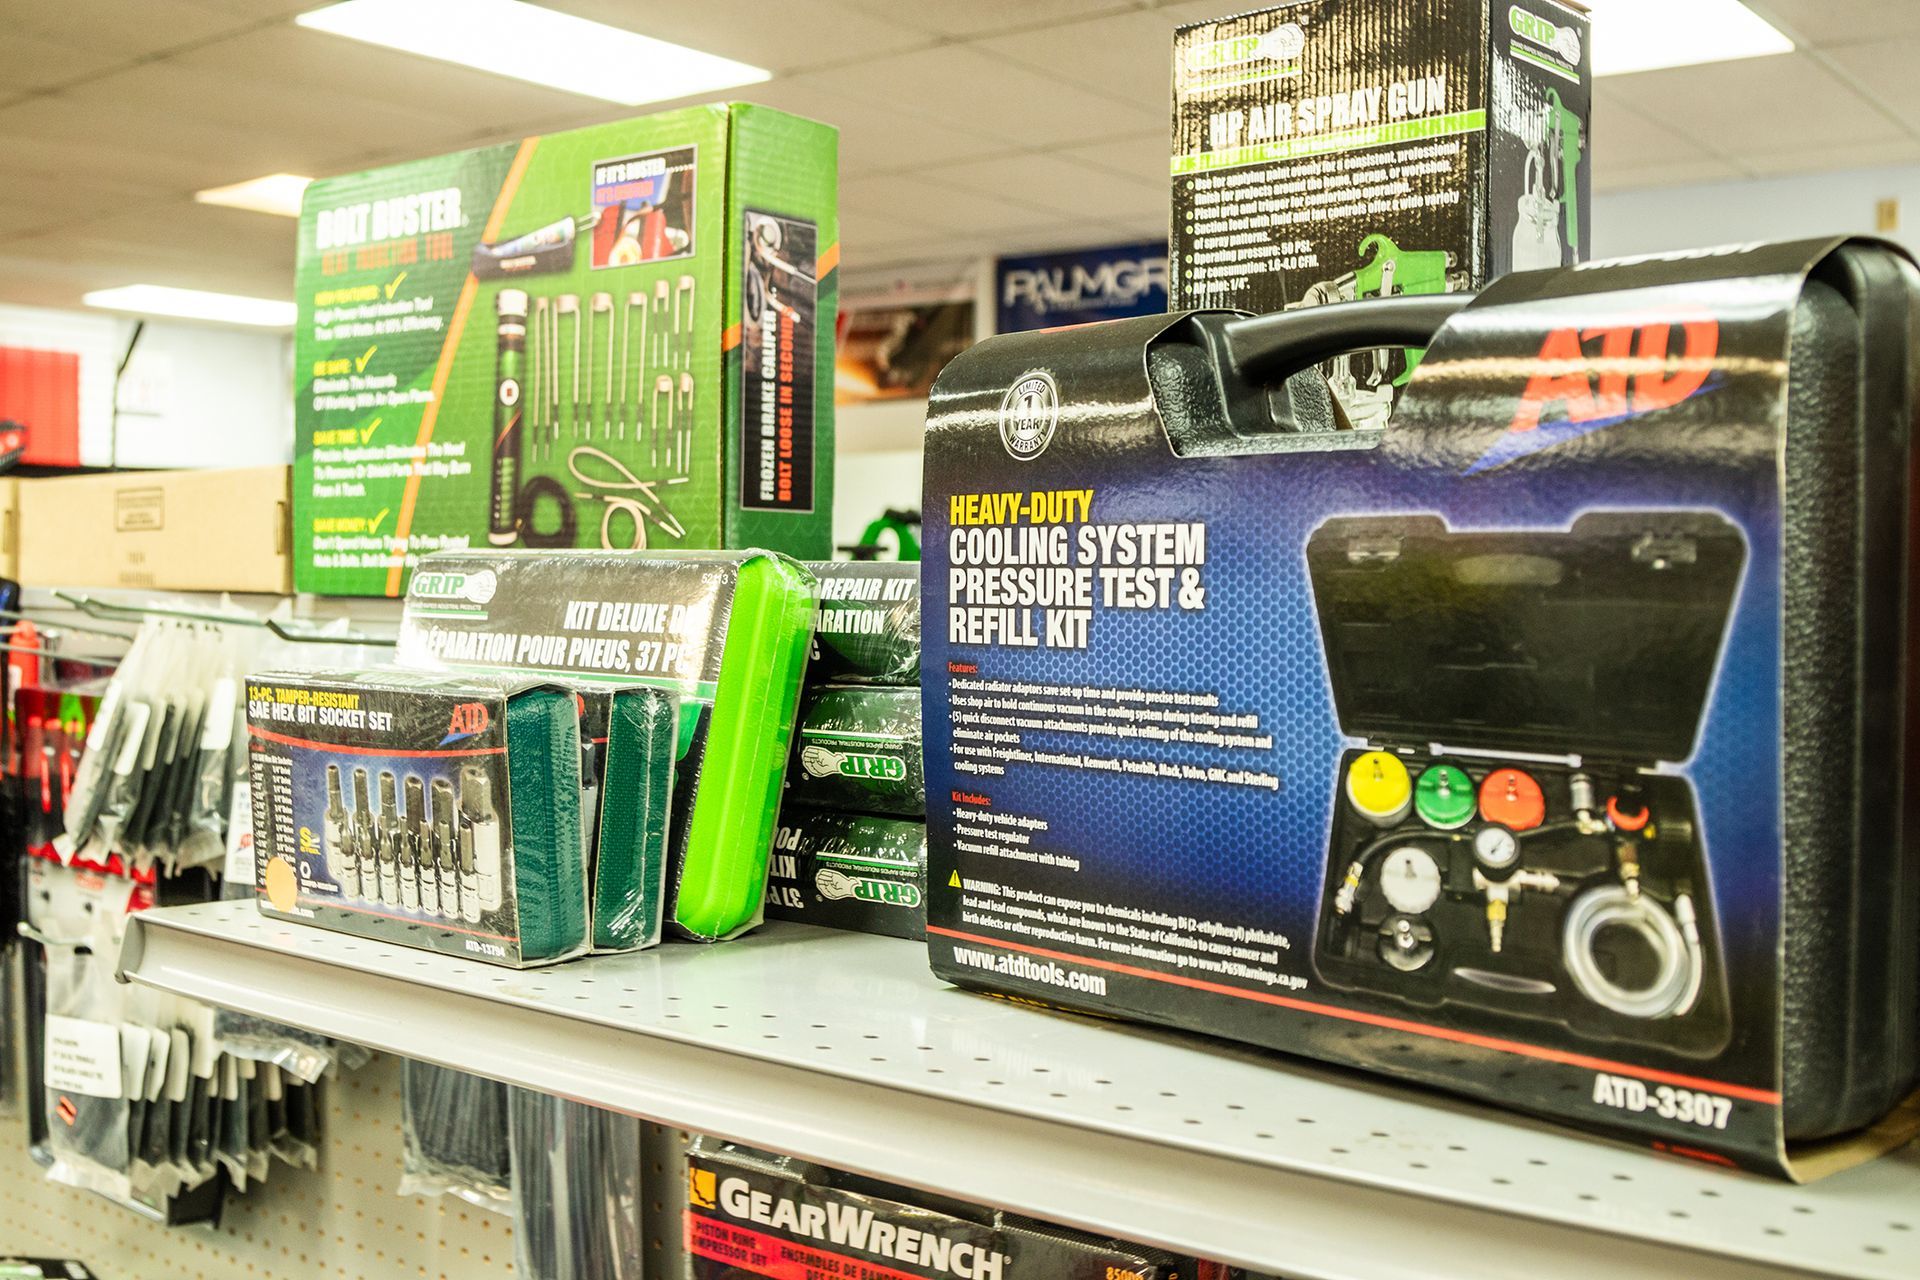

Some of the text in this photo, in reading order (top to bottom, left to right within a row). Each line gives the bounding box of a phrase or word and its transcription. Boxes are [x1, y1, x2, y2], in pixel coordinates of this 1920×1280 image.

[1508, 5, 1559, 46] GRIP
[1210, 111, 1243, 146] HP
[1248, 102, 1292, 141] AIR
[1298, 86, 1382, 133] SPRAY
[1388, 74, 1446, 118] GUN
[316, 187, 462, 250] BOLT BUSTER
[1193, 255, 1319, 280] Air consumption: 1.6-4.0 CFM.
[1194, 249, 1237, 267] Operating
[1281, 242, 1294, 256] 50
[1295, 241, 1312, 254] PSI.
[1193, 282, 1206, 295] Air
[1509, 304, 1719, 433] ATD
[780, 386, 793, 404] IN
[1018, 381, 1046, 395] LIMITED
[760, 309, 777, 501] FROZEN BRAKE CALIPER
[1024, 395, 1033, 415] 1
[779, 407, 793, 459] LOOSE
[1014, 418, 1040, 431] YEAR
[1009, 429, 1047, 451] WARRANTY
[778, 461, 793, 501] BOLT
[950, 490, 1094, 525] HEAVY-DUTY
[950, 523, 1205, 565] COOLING SYSTEM
[415, 575, 465, 595] GRIP
[821, 578, 916, 600] REPAIR KIT
[950, 567, 1205, 610] PRESSURE TEST &
[563, 600, 598, 631] KIT
[597, 602, 669, 633] DELUXE
[950, 607, 1092, 648] REFILL KIT
[516, 634, 567, 666] POUR
[567, 637, 632, 673] PNEUS,
[635, 640, 661, 672] 37
[948, 661, 978, 673] Features:
[249, 687, 359, 709] 13-PC. TAMPER-RESISTANT
[952, 678, 1219, 707] Dedicated radiator adaptors save set-up time and provide precise test results
[249, 700, 393, 731] SAE HEX BIT SOCKET SET
[448, 702, 489, 735] ATD
[952, 695, 1258, 729] Uses shop air to hold continuous vacuum in the cooling system during testing and refill
[952, 711, 1272, 749] (5) quick disconnect vacuum attachments provide quick refilling of the cooling system and
[953, 728, 1020, 744] eliminate air pockets
[840, 755, 904, 780] GRIP
[953, 744, 965, 755] For
[964, 747, 976, 756] use
[977, 746, 992, 758] with
[992, 747, 1034, 763] Freightliner,
[1034, 751, 1083, 768] International,
[1084, 756, 1122, 772] Kenworth,
[1123, 760, 1158, 776] Peterbilt,
[1158, 763, 1183, 779] Mack,
[1182, 765, 1208, 781] Volvo,
[1227, 771, 1243, 784] and
[1244, 771, 1279, 791] Sterling
[954, 760, 1005, 775] cooling systems
[952, 791, 991, 806] Kit Includes:
[956, 808, 1048, 831] Heavy-duty vehicle adapters
[956, 823, 1030, 844] Pressure test regulator
[775, 827, 803, 851] PO
[770, 855, 797, 879] KIT
[956, 839, 1080, 872] Vacuum refill attachment with tubing
[782, 887, 805, 909] 37
[853, 879, 920, 907] GRIP
[954, 946, 1106, 996] www.atdtools.com
[1592, 1072, 1733, 1130] ATD-3307
[696, 1221, 728, 1241] PISTON
[750, 1249, 767, 1266] SET
[781, 1246, 857, 1277] ENSEMBLES DE
